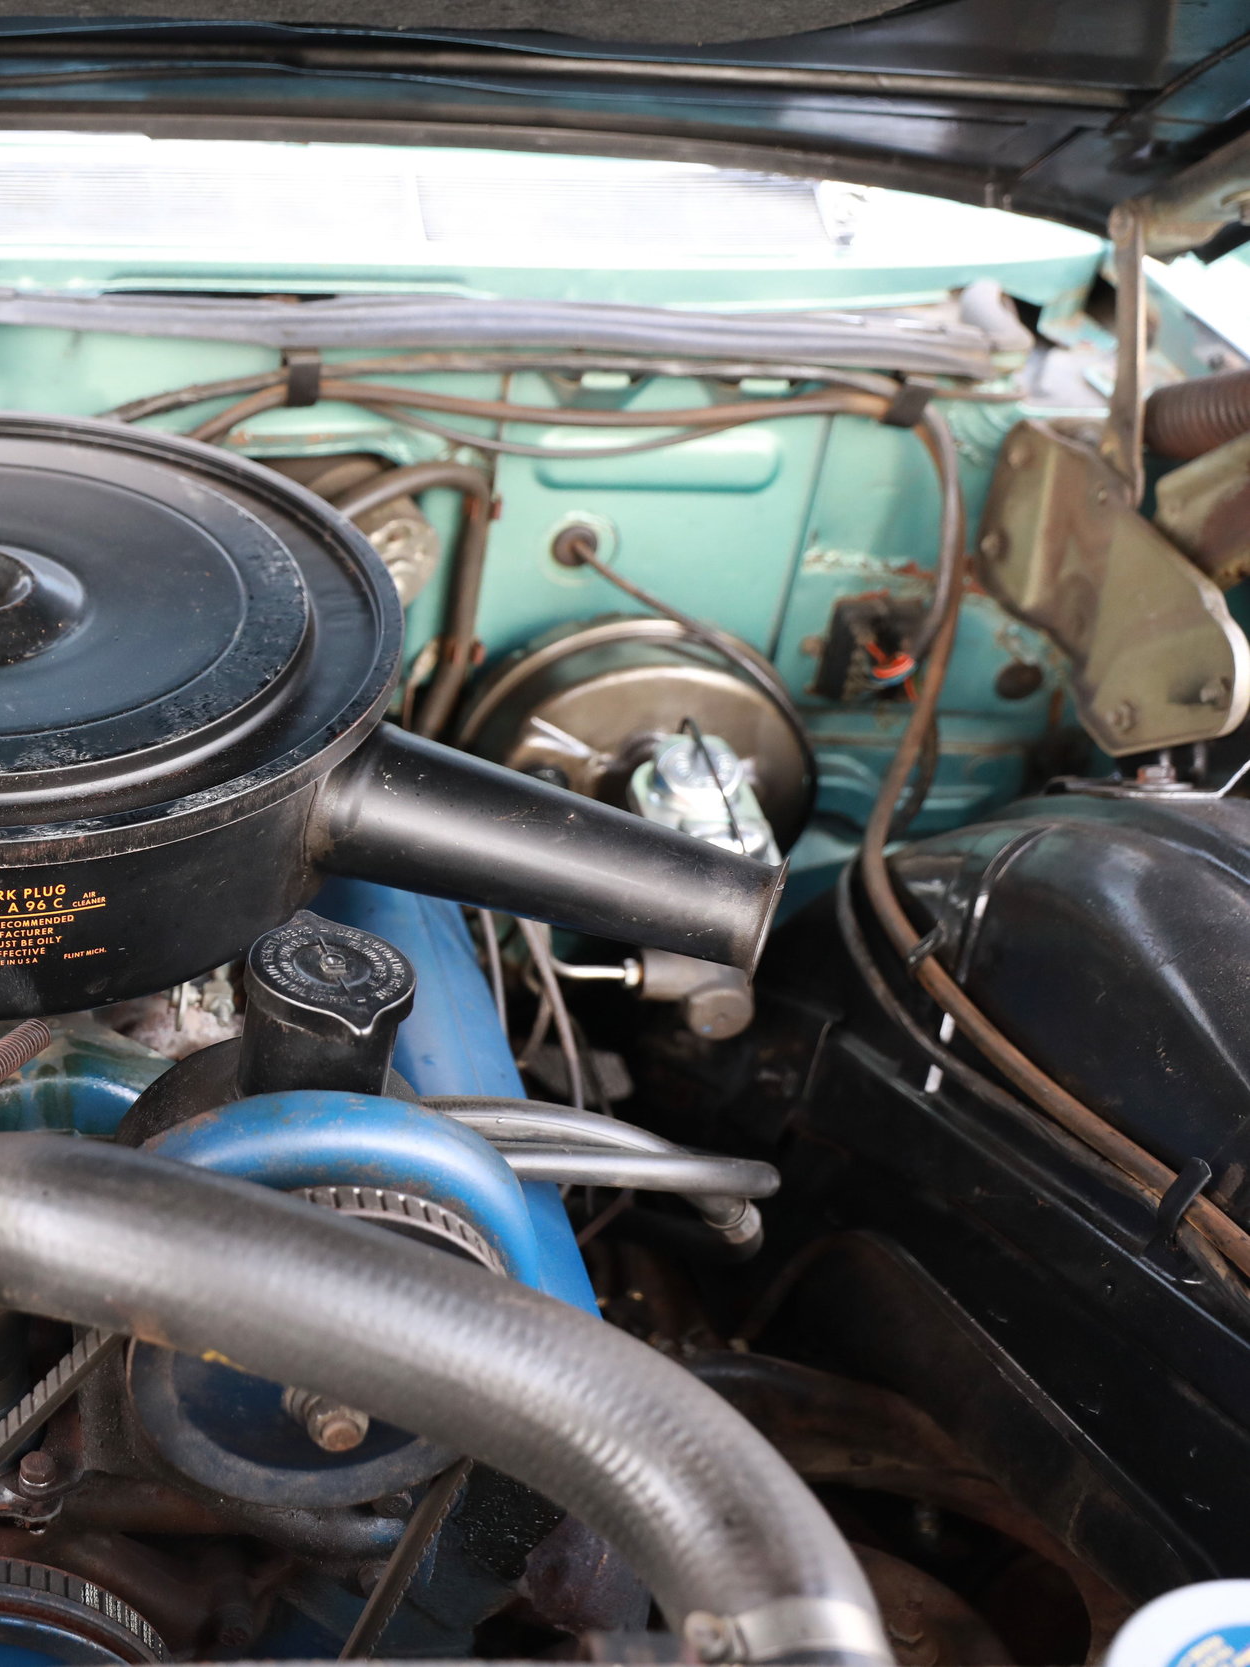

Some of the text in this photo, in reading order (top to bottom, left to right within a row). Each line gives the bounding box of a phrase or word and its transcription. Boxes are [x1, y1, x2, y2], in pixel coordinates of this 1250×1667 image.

[24, 884, 66, 897] PLUG
[8, 902, 19, 913] A
[25, 900, 46, 911] 96
[53, 898, 64, 909] C
[72, 891, 106, 908] AIR CLEANER
[20, 939, 34, 947] BE
[36, 935, 63, 946] OILY
[63, 948, 107, 959] FLINT MICH.
[5, 958, 15, 966] IN
